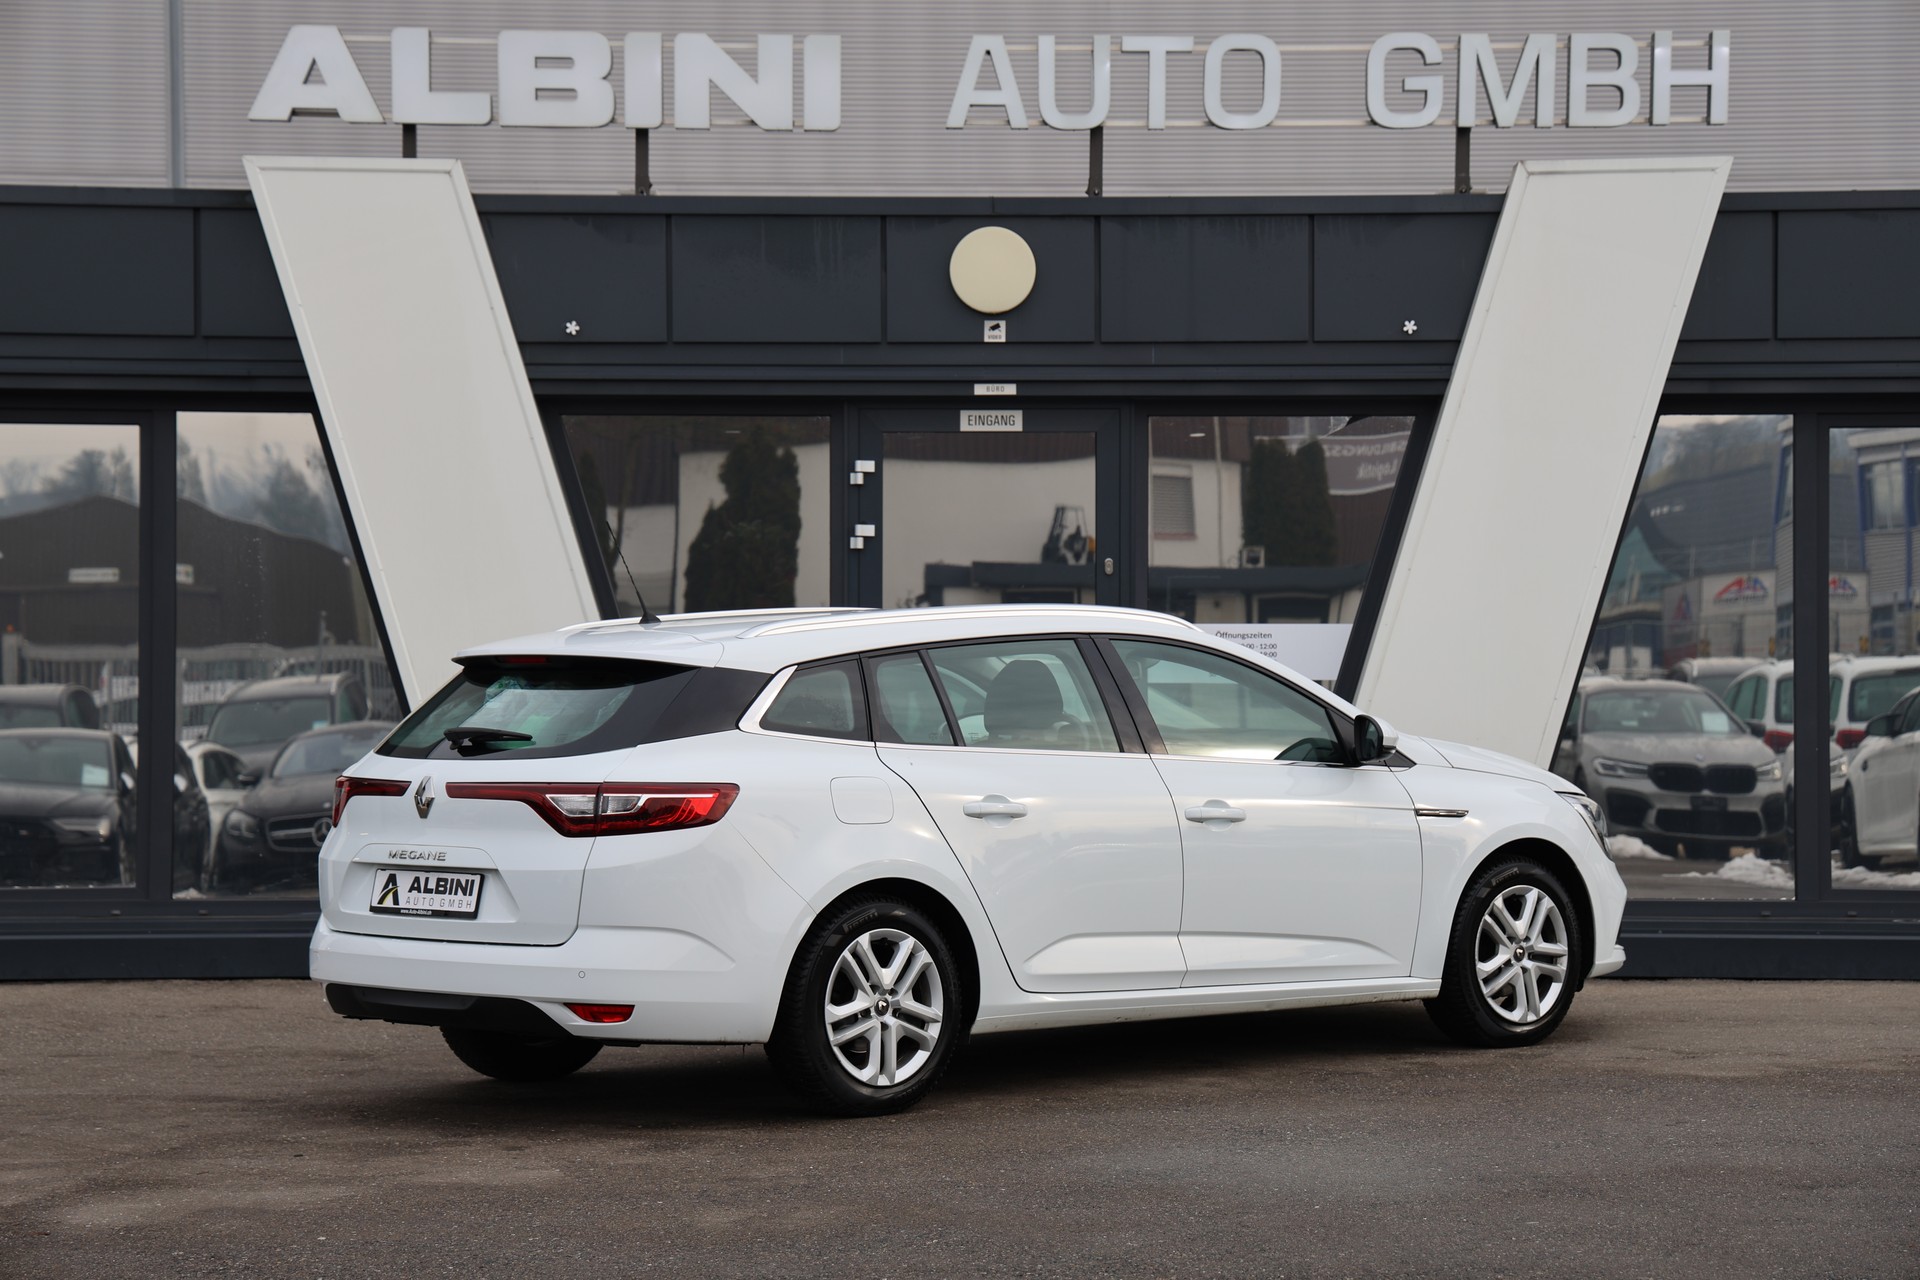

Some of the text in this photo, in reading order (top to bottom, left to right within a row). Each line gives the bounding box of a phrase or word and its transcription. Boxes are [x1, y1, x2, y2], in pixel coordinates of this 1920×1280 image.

[248, 24, 1731, 131] ALBINI AUTO GMBH
[967, 414, 1016, 427] EINGANG
[1215, 630, 1273, 640] Öffnungszeiten
[388, 850, 448, 862] MEGANE
[408, 876, 475, 897] ALBINI
[405, 896, 473, 909] AUTO GMBH
